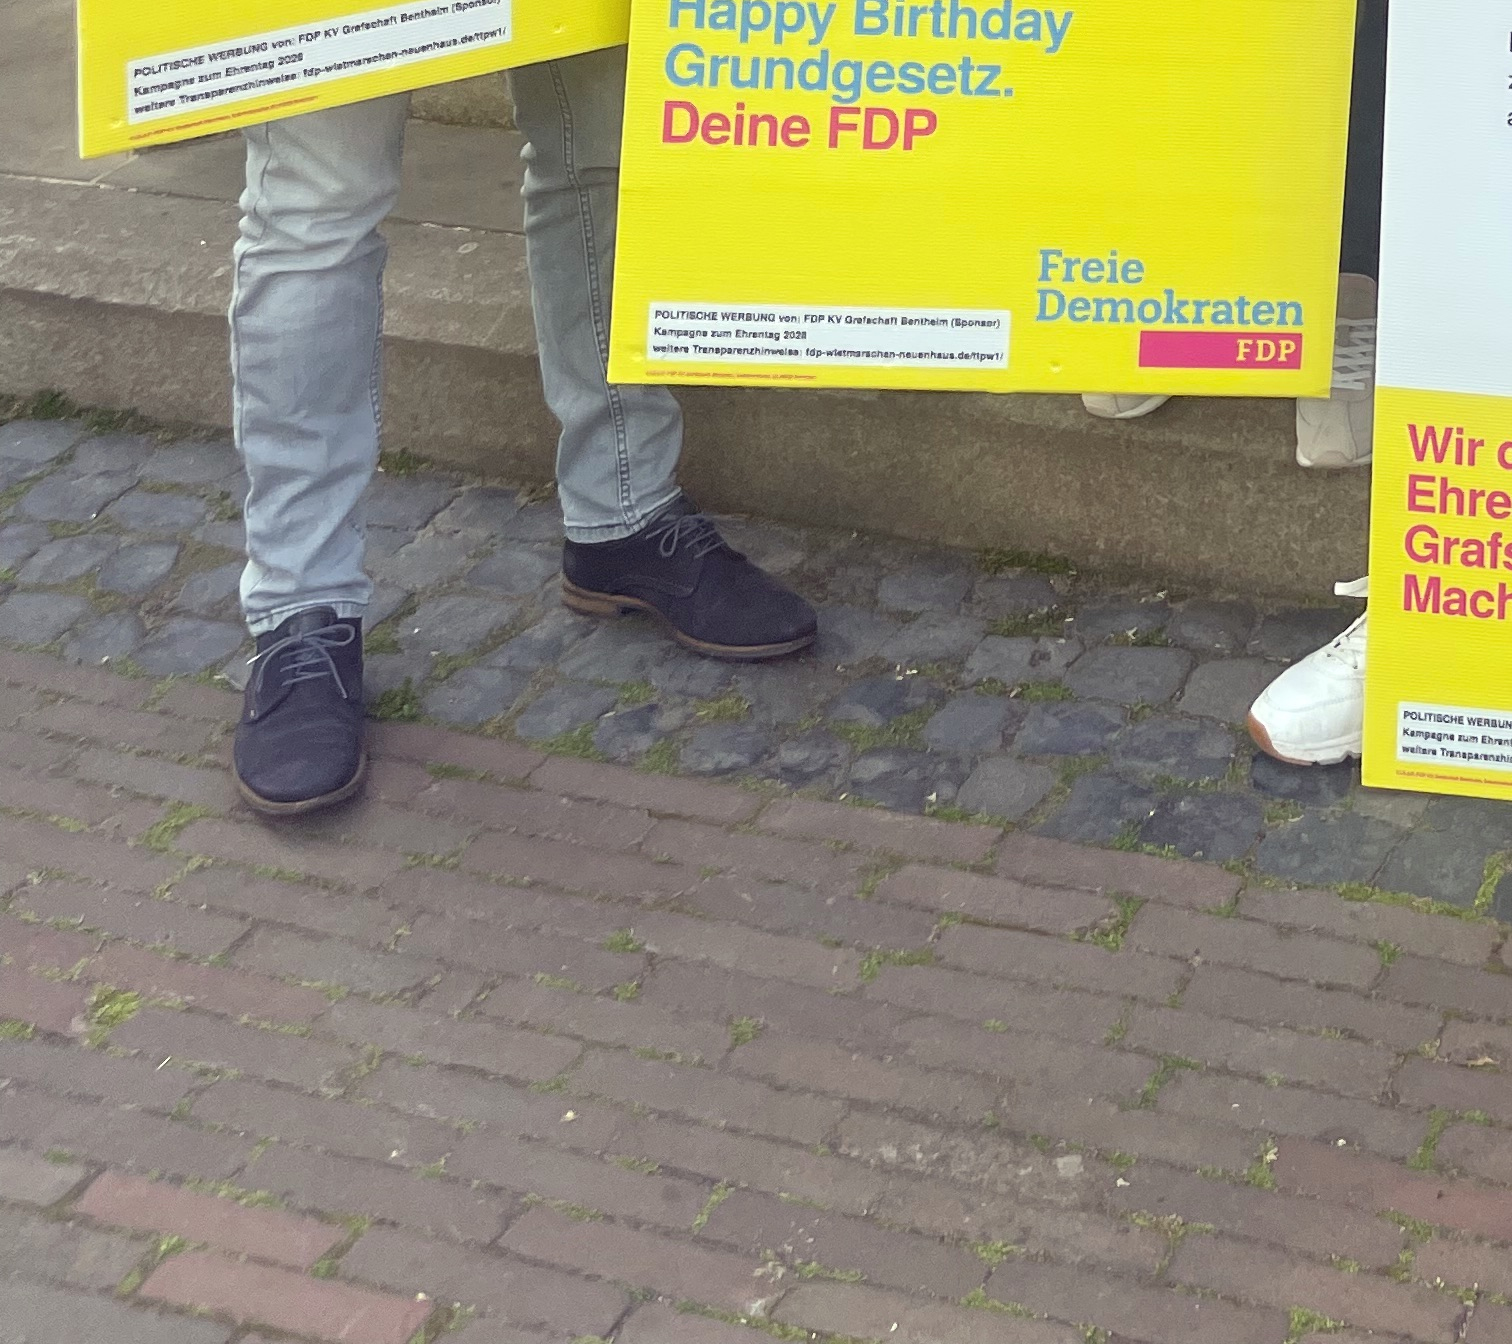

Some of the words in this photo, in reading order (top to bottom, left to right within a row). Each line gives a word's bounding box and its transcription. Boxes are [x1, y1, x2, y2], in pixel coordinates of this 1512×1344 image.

[665, 43, 1013, 107] Grundgesetz.
[662, 100, 810, 148] Deine
[827, 107, 938, 152] FDP
[1039, 249, 1144, 284] Freie
[1036, 288, 1303, 326] Demokraten
[1238, 339, 1296, 362] FDP
[1409, 424, 1485, 466] Wir
